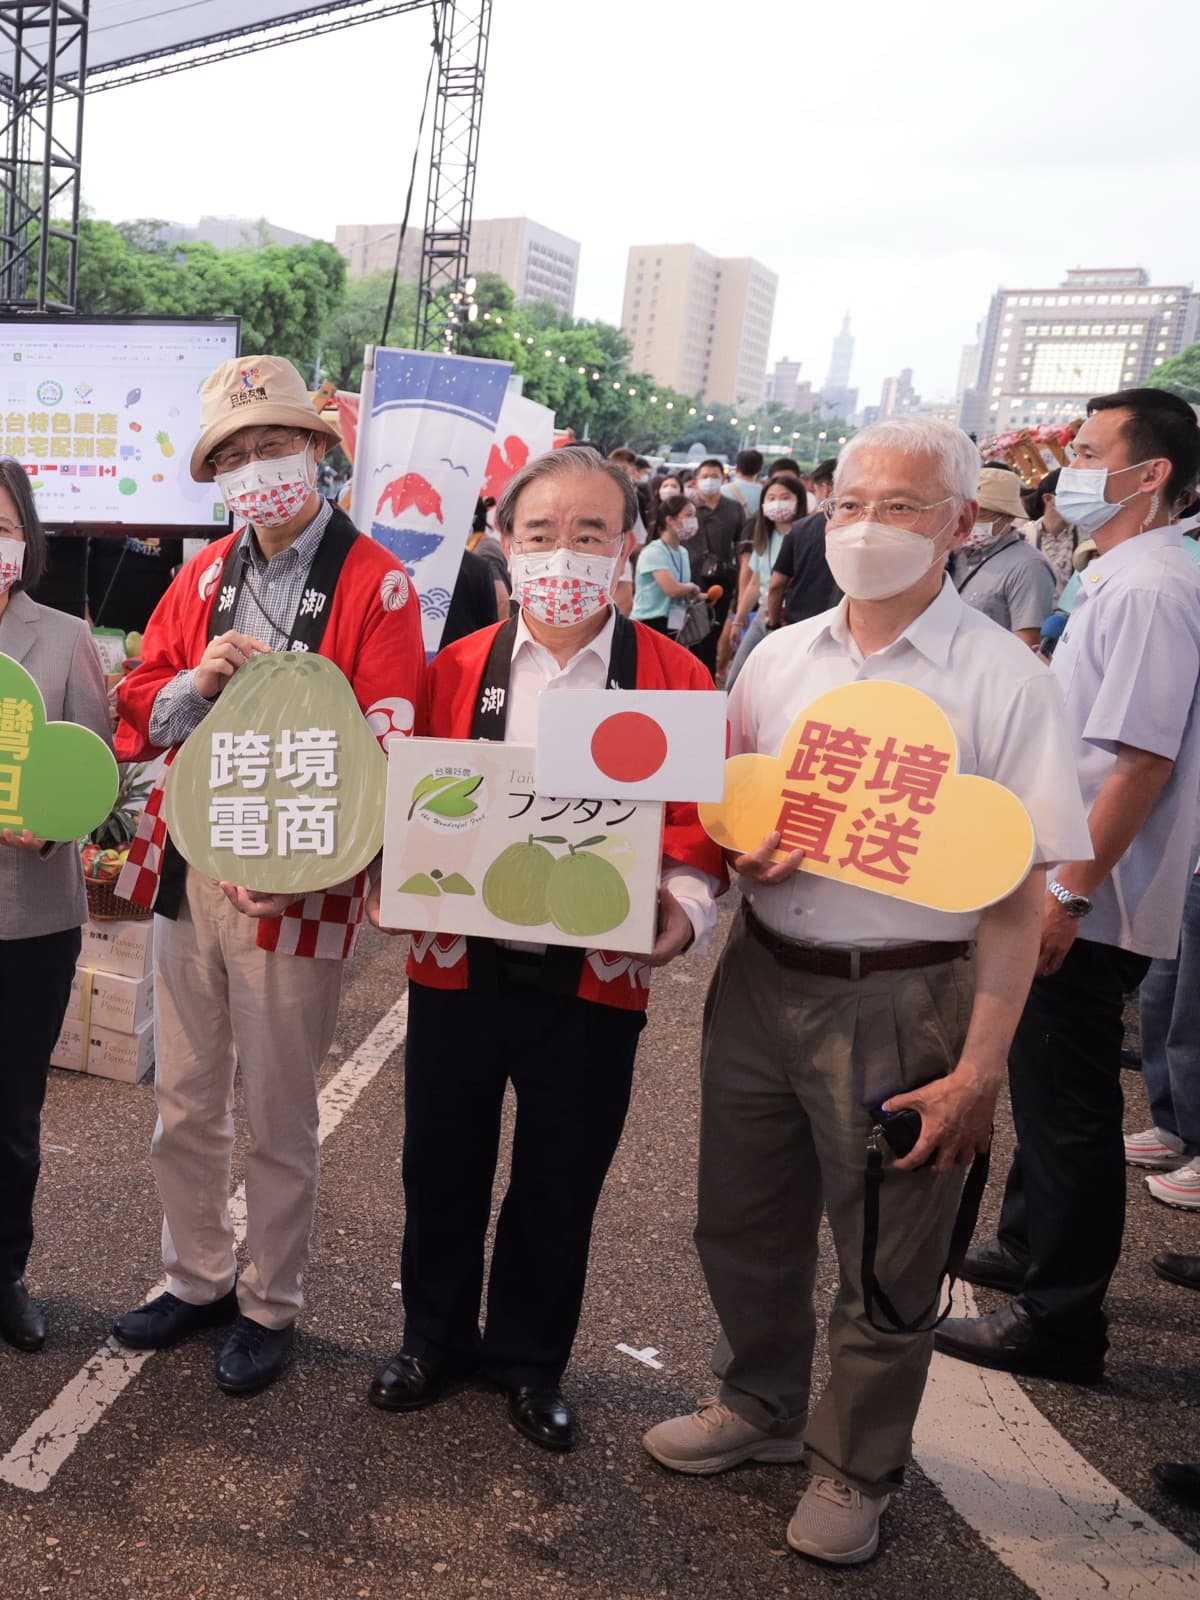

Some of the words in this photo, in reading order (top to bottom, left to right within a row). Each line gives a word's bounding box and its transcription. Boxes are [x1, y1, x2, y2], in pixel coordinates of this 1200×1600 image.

[480, 686, 506, 716] 御
[209, 728, 338, 789] 跨境
[785, 720, 950, 815] 跨境
[209, 794, 338, 857] 電商
[774, 789, 922, 885] 直送
